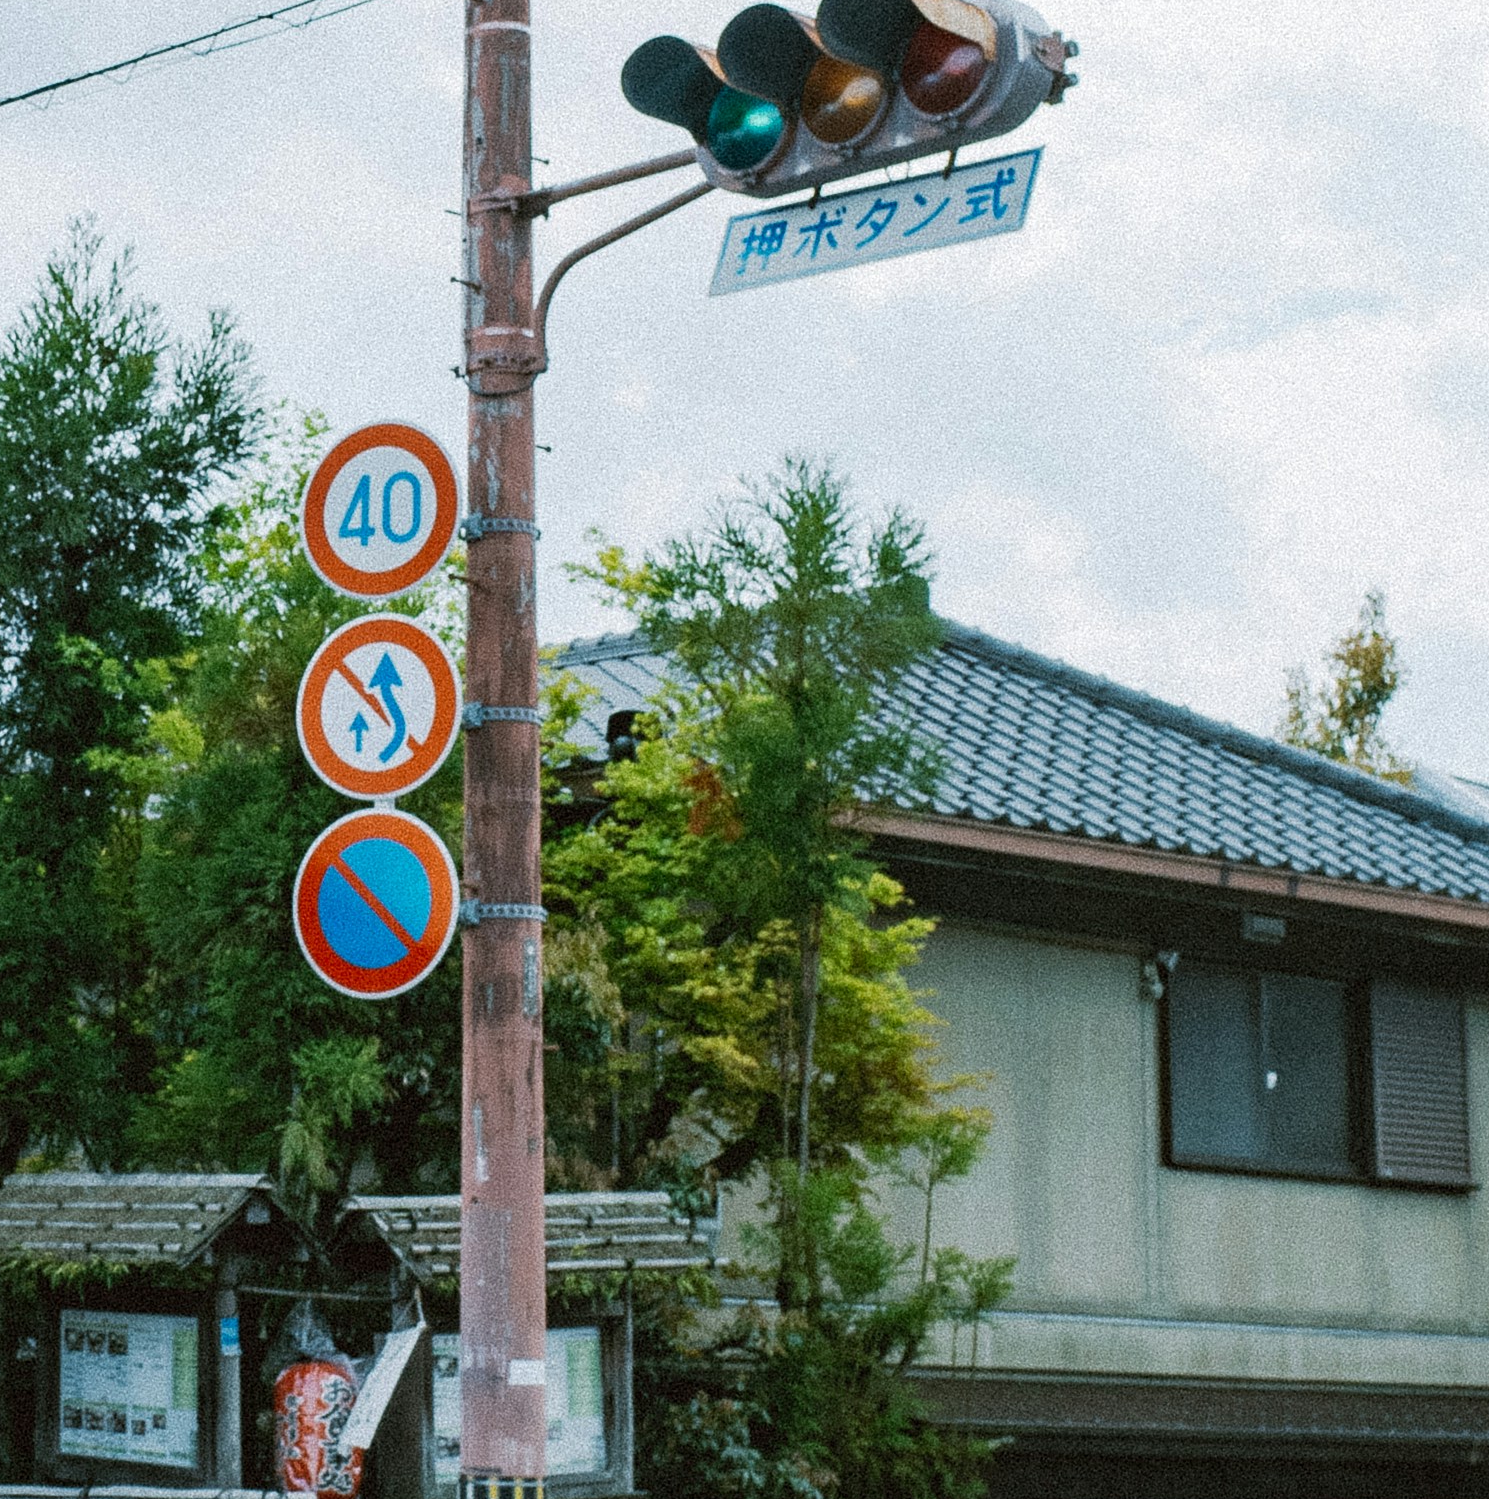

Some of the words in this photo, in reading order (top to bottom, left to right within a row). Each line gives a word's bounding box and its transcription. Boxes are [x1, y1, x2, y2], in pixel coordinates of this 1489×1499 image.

[737, 168, 1016, 275] 押ボタン式
[339, 471, 421, 546] 40
